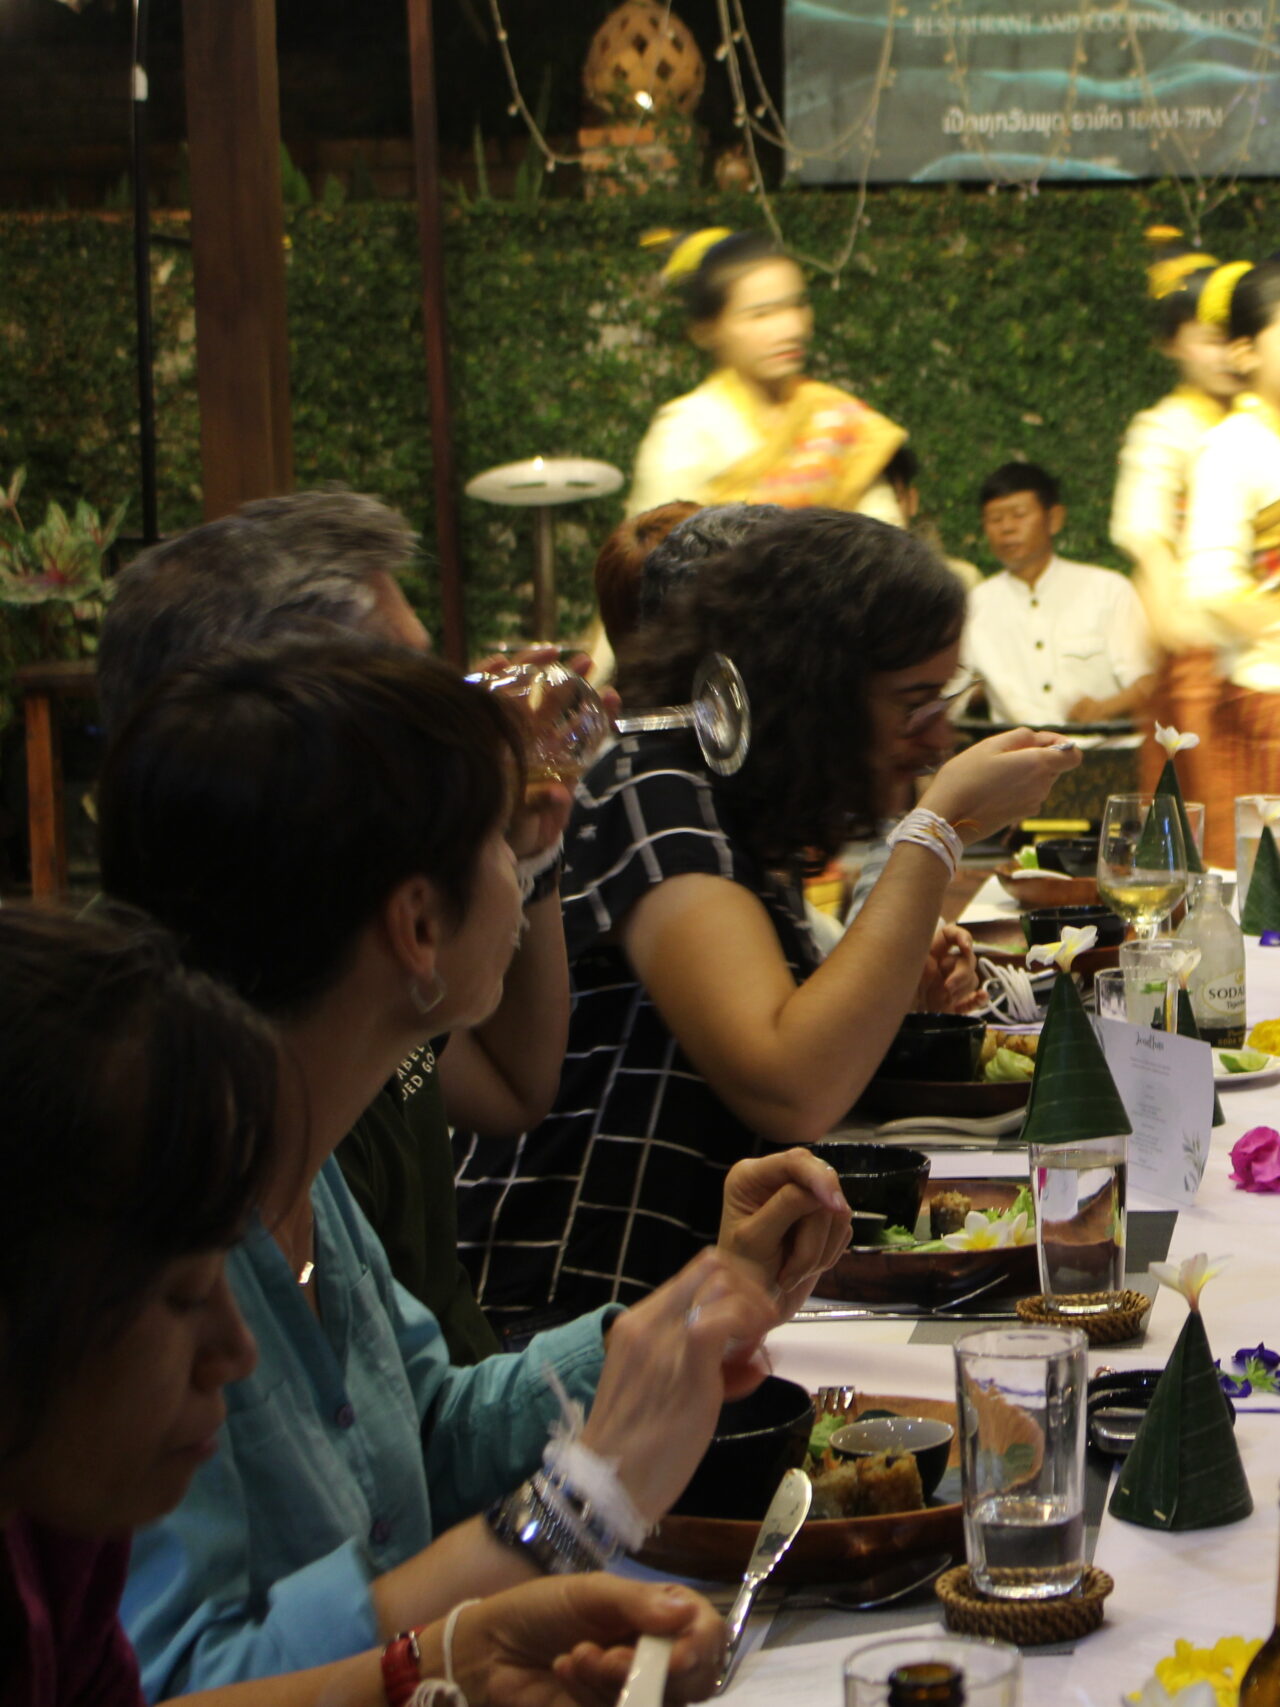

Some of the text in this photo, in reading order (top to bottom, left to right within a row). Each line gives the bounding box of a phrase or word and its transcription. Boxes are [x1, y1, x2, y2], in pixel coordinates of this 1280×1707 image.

[913, 8, 1264, 36] RESTAURANT AND COOKING SCHOOL
